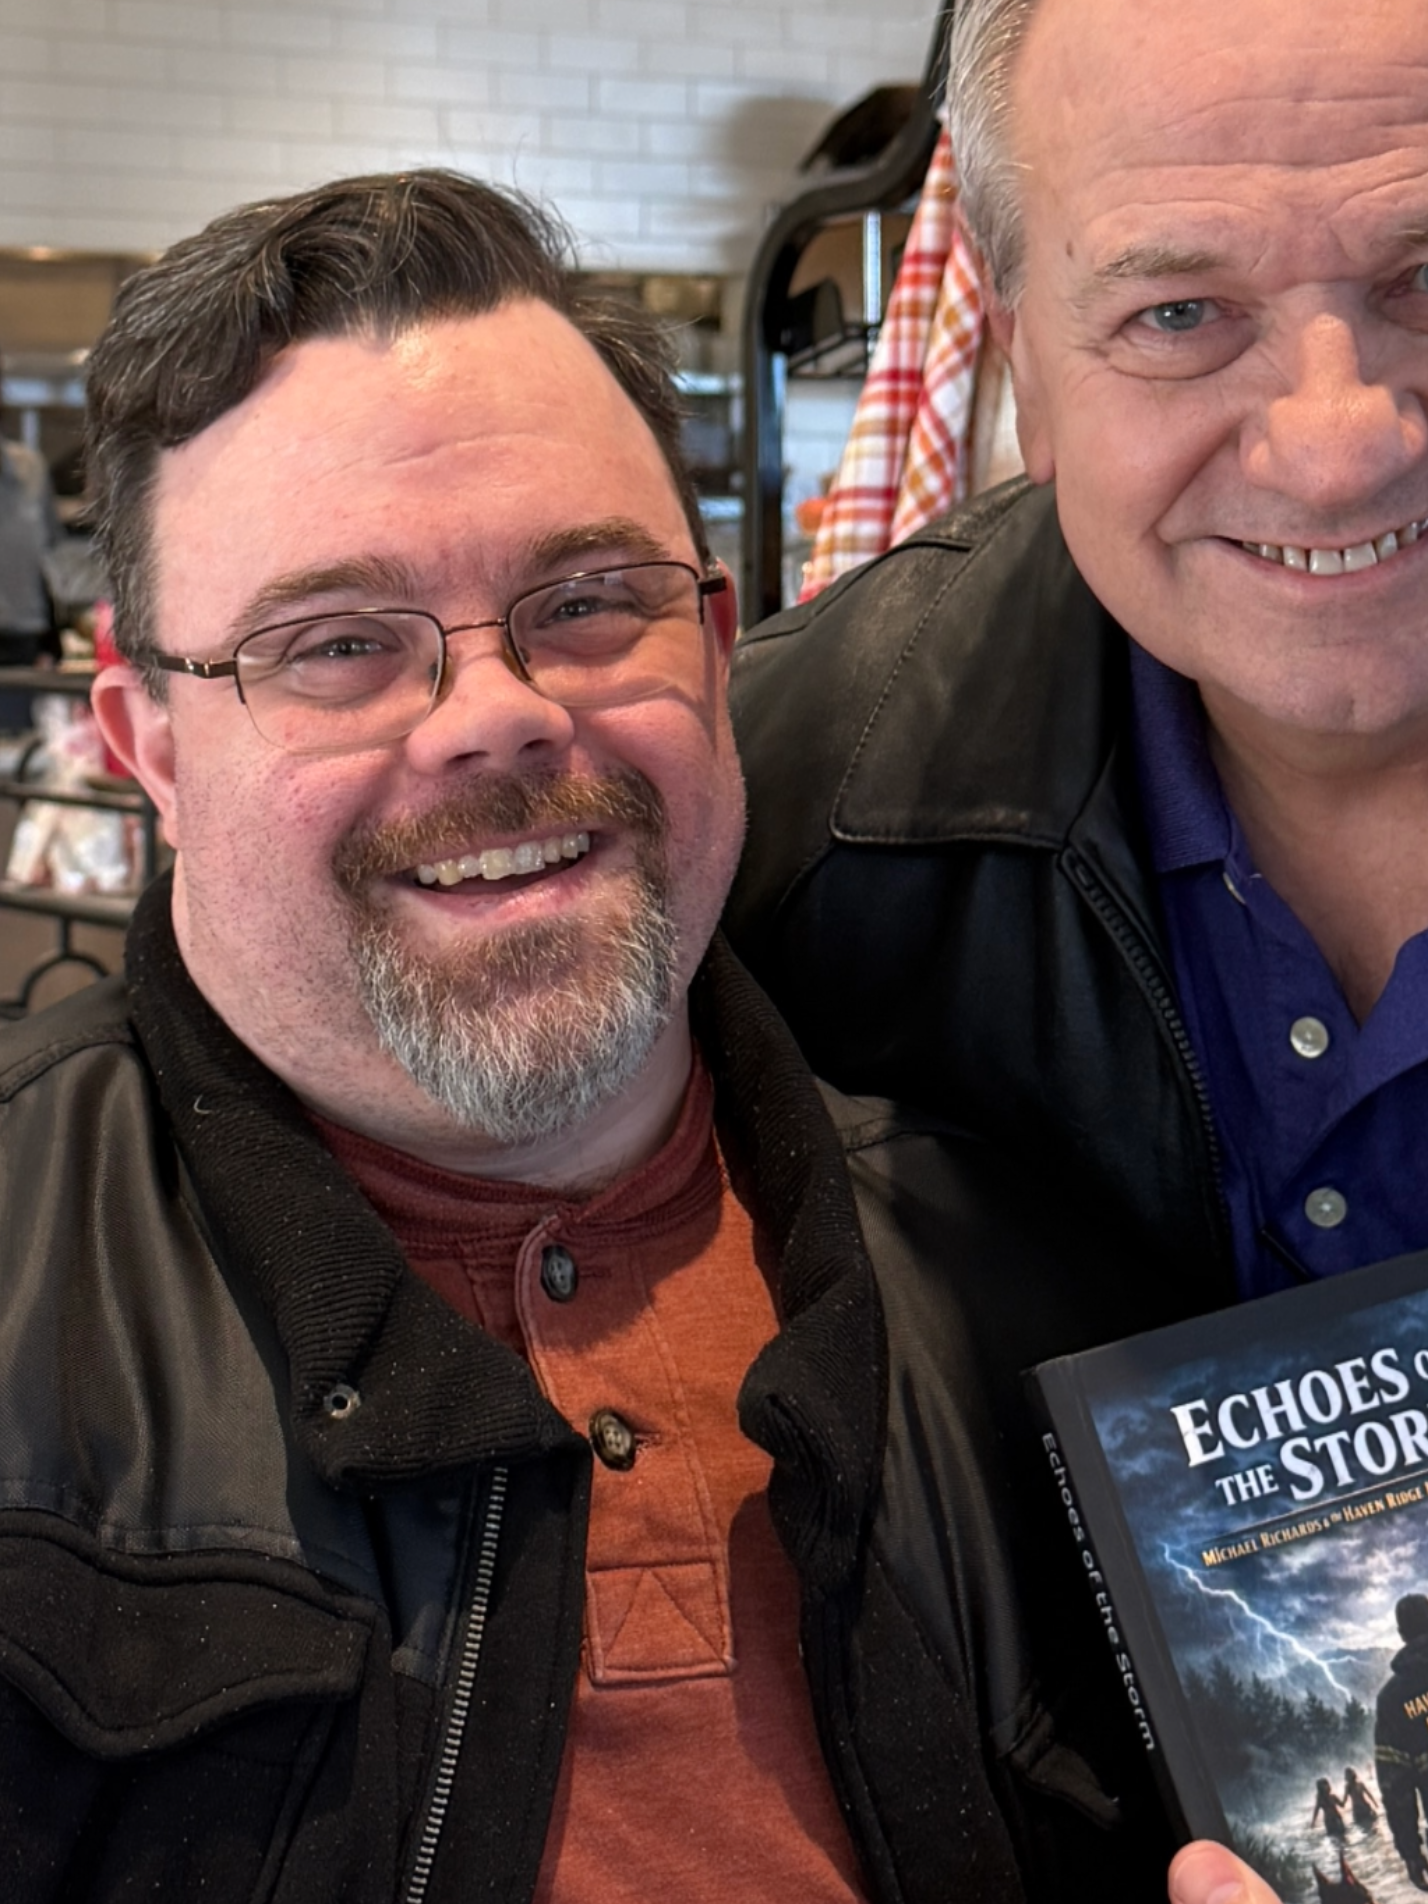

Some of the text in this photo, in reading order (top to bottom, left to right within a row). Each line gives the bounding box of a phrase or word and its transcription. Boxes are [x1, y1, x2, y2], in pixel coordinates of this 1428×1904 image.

[1170, 1347, 1411, 1468] ECHOES
[1201, 1538, 1259, 1567] MICHAEL
[1259, 1518, 1323, 1549] RICHARDS
[1342, 1498, 1385, 1522] HAVEN
[1385, 1486, 1423, 1510] RIDGE
[1214, 1463, 1280, 1506] THE
[1041, 1432, 1086, 1543] Echoes
[1095, 1591, 1120, 1645] the
[1115, 1652, 1156, 1751] Storm
